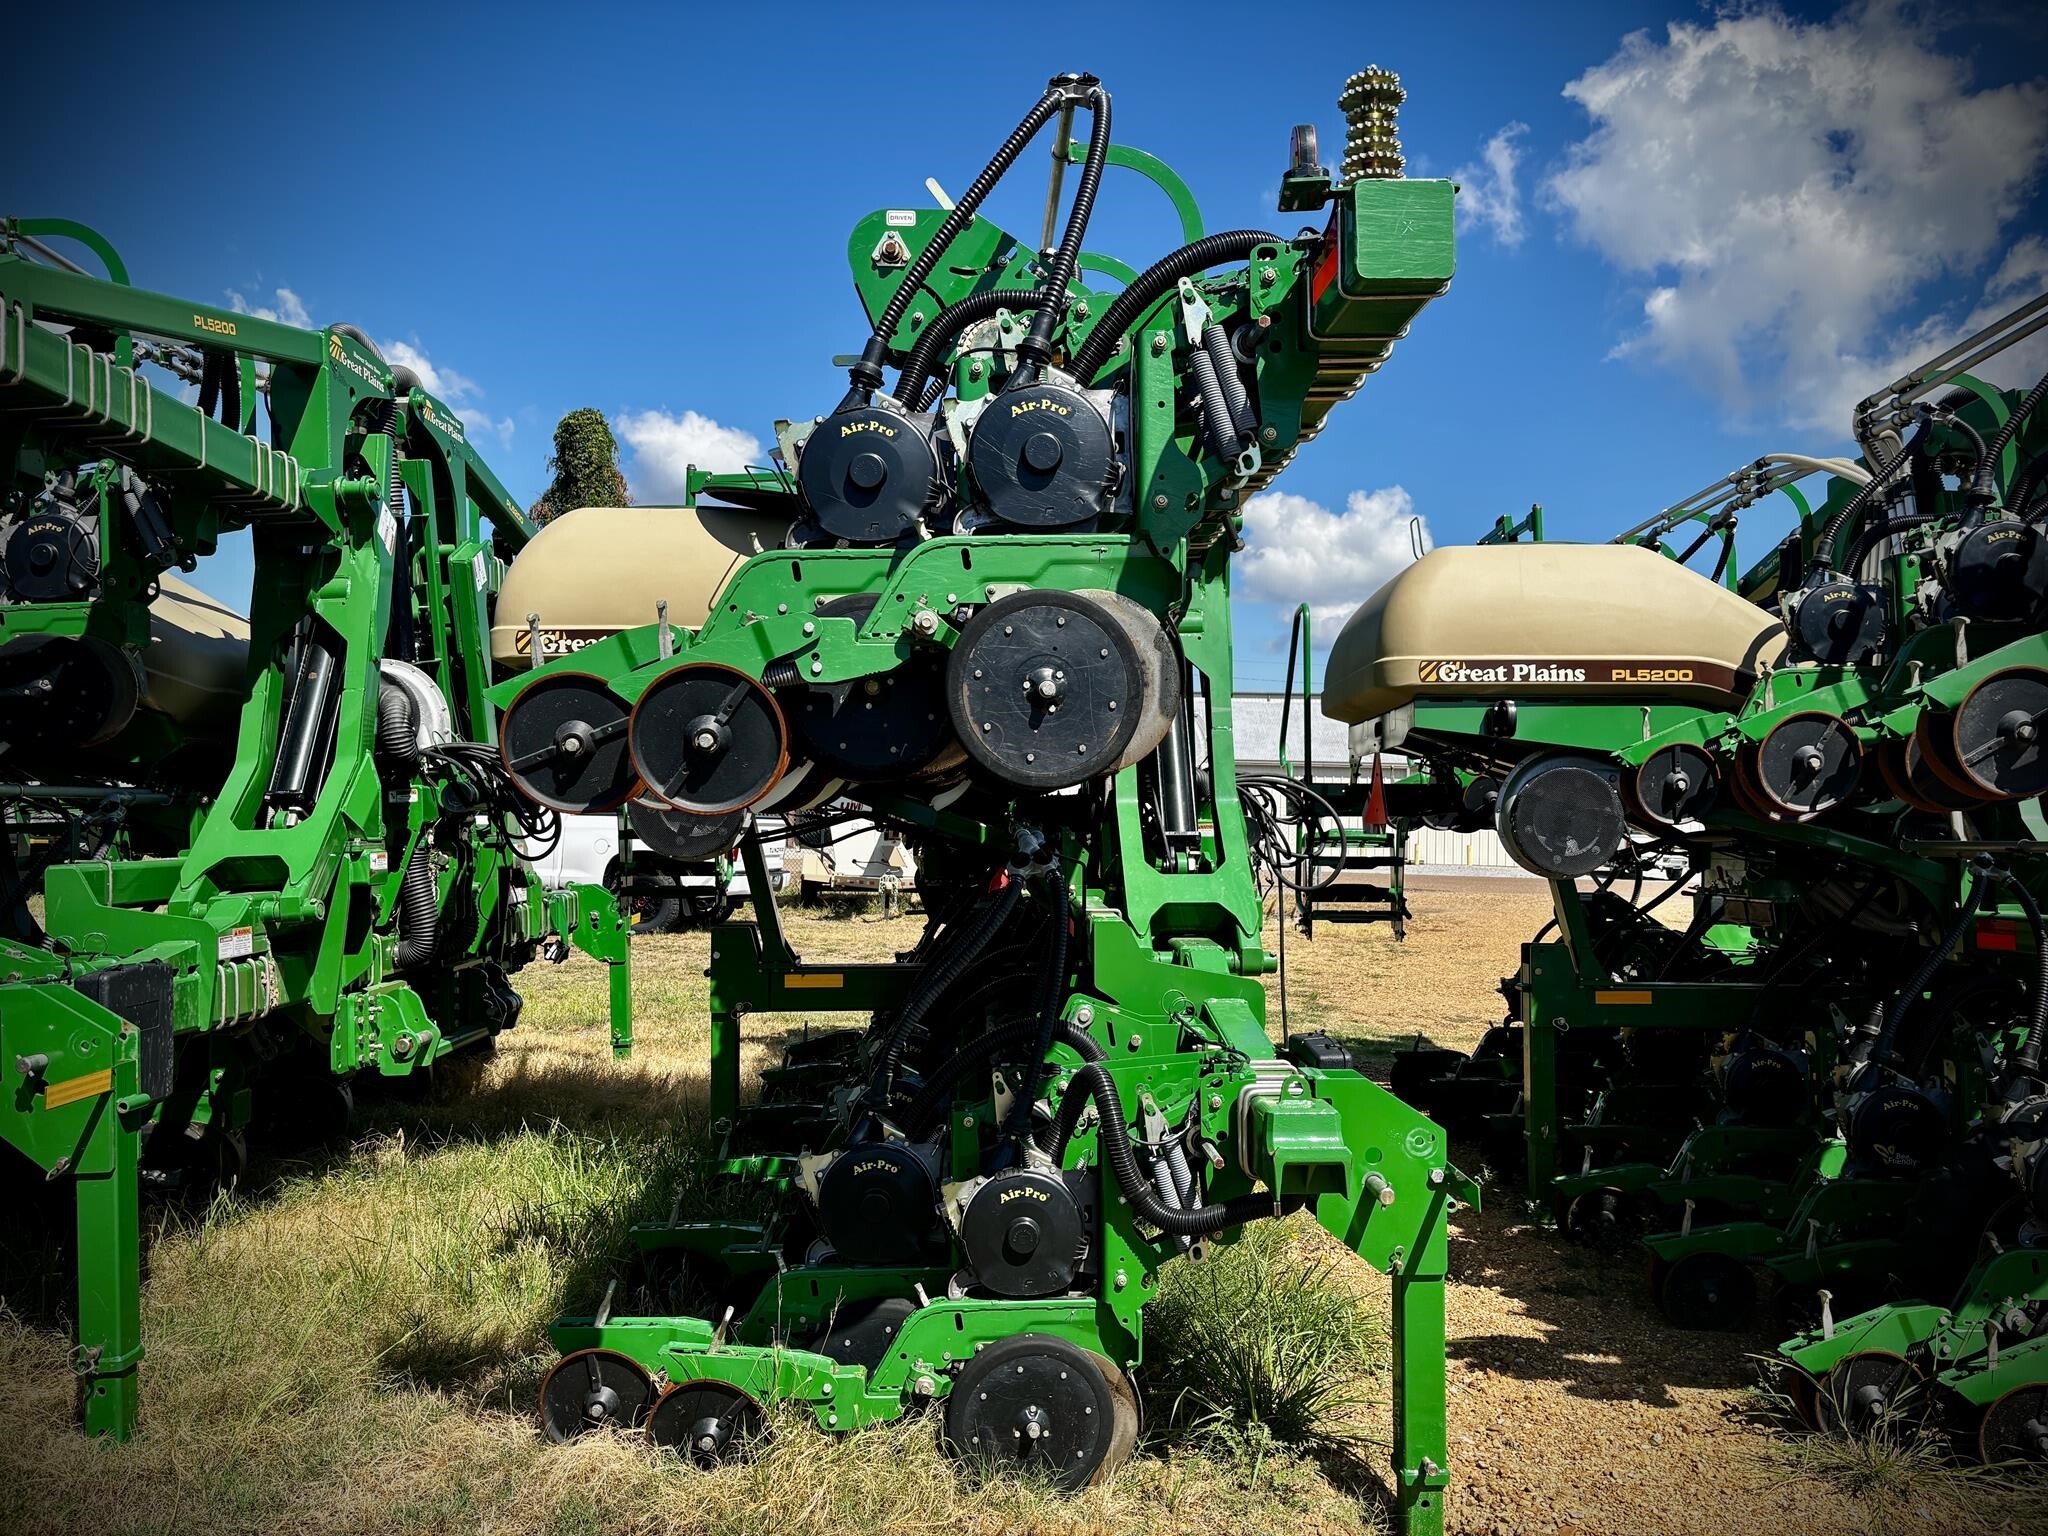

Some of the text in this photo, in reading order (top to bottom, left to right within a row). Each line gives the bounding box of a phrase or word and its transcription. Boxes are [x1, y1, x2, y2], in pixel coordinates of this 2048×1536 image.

[193, 315, 237, 336] PL5200
[340, 351, 363, 377] Great
[363, 367, 385, 393] Plains
[1010, 399, 1069, 418] Air-Pro
[431, 412, 448, 433] Great
[447, 423, 464, 444] Plains
[840, 420, 895, 438] Air-Pro
[28, 522, 64, 536] Air-Pro
[1437, 663, 1694, 683] Great Plains PL5200
[852, 1159, 899, 1176] Air-Pro
[1000, 1187, 1048, 1204] Air-Pro
